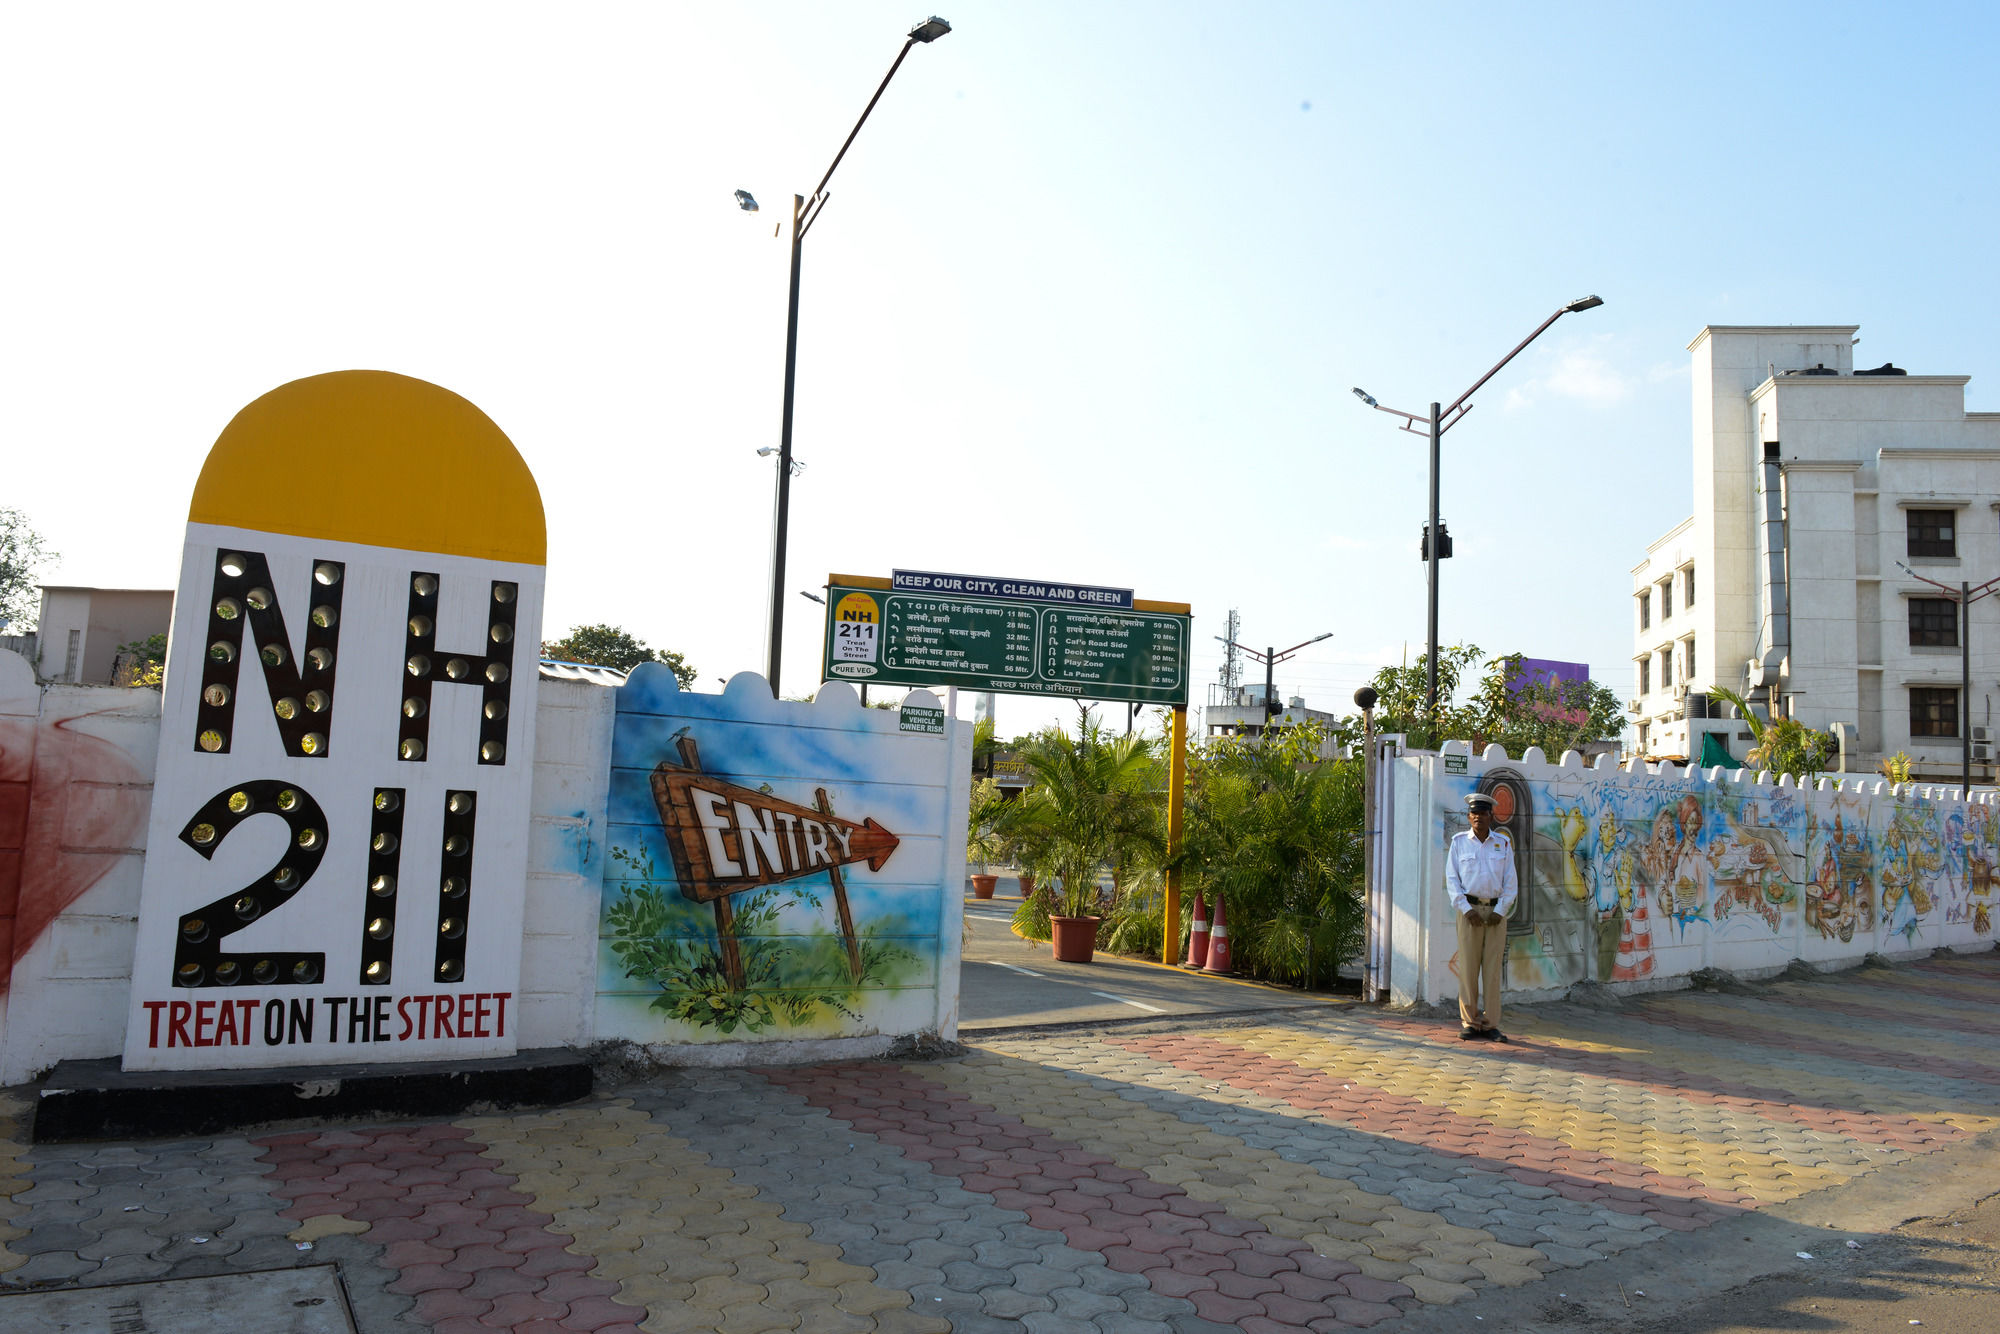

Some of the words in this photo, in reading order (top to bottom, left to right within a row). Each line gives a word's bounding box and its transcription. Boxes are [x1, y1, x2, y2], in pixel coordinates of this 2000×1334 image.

[895, 574, 930, 587] KEEP
[933, 578, 962, 590] OUR
[965, 580, 997, 594] CITY,
[1002, 583, 1046, 597] CLEAN
[1048, 587, 1076, 600] AND
[1078, 590, 1121, 603] GREEN
[843, 610, 872, 622] NH
[839, 623, 873, 639] 211
[1017, 622, 1031, 630] Mtr.
[1016, 644, 1030, 652] Mtr.
[1110, 641, 1128, 649] Side
[194, 547, 519, 766] NH
[1064, 648, 1085, 656] Deck
[1100, 651, 1125, 659] Street
[1015, 665, 1029, 673] Mtr.
[1064, 659, 1082, 667] Play
[1083, 660, 1104, 668] Zone
[1075, 670, 1100, 679] Panda
[990, 680, 1017, 689] स्वच्छ
[1019, 682, 1043, 691] भारत
[1044, 682, 1083, 694] अभियान
[902, 708, 933, 717] PARKING
[909, 716, 936, 725] VEHICLE
[900, 722, 925, 732] OWNER
[926, 725, 944, 733] RISK
[690, 785, 855, 879] ENTRY
[172, 779, 477, 988] 211
[143, 999, 260, 1048] TREAT
[263, 998, 314, 1046] ON
[322, 995, 392, 1043] THE
[397, 991, 511, 1042] STREET
